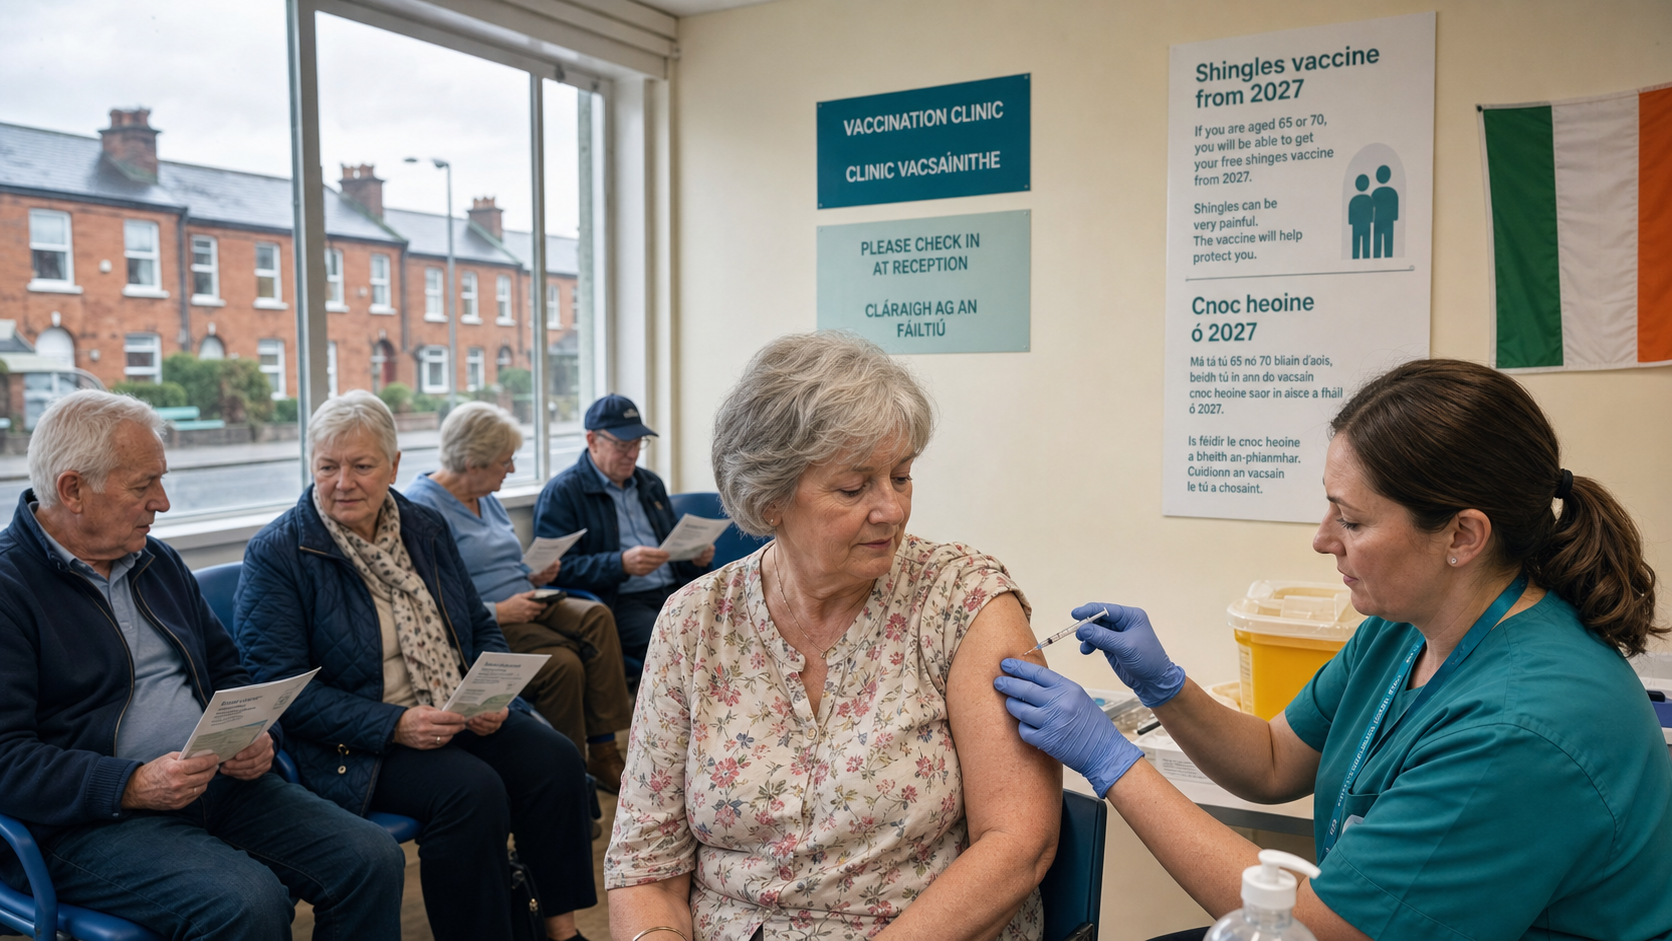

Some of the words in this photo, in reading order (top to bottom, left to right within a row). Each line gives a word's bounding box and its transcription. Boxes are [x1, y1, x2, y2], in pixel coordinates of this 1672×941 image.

[1196, 57, 1285, 82] Shingles
[1292, 46, 1380, 71] vaccine
[1196, 88, 1243, 108] from
[1251, 79, 1304, 103] 2027
[844, 107, 947, 136] VACCINATION
[951, 100, 1003, 123] CLINIC
[1195, 124, 1202, 137] If
[1205, 126, 1225, 139] you
[1228, 124, 1245, 134] are
[1248, 117, 1275, 134] aged
[1279, 116, 1292, 129] 65
[1296, 117, 1307, 127] or
[1310, 113, 1327, 126] 70,
[1195, 143, 1214, 156] you
[1217, 139, 1236, 151] will
[1238, 137, 1251, 149] be
[1255, 135, 1277, 147] able
[1281, 134, 1292, 145] to
[1295, 131, 1313, 146] get
[846, 161, 894, 182] CLINIC
[898, 150, 1000, 177] VACSAÍNITHE
[1194, 159, 1218, 172] your
[1222, 155, 1242, 167] free
[1246, 152, 1287, 166] shinges
[1291, 147, 1334, 161] vaccine
[1194, 174, 1219, 186] from
[1223, 170, 1251, 184] 2027.
[1194, 200, 1239, 215] Shingles
[1242, 200, 1261, 210] can
[1264, 197, 1277, 209] be
[1194, 220, 1216, 232] very
[1220, 215, 1258, 231] painful.
[862, 237, 911, 256] PLEASE
[915, 233, 961, 251] CHECK
[966, 232, 979, 248] IN
[1193, 234, 1213, 246] The
[1216, 232, 1256, 245] vaccine
[1259, 229, 1276, 242] will
[1280, 228, 1302, 242] help
[873, 260, 889, 275] AT
[893, 255, 967, 274] RECEPTION
[1194, 250, 1231, 265] protect
[1235, 250, 1257, 263] you.
[865, 299, 931, 317] CLÁRAIGH
[935, 300, 954, 315] AG
[958, 298, 977, 314] AN
[1192, 296, 1240, 315] Cnoc
[1247, 292, 1314, 313] heoine
[897, 318, 945, 337] FÁILTIÚ
[1192, 322, 1203, 342] ó
[1209, 321, 1257, 342] 2027
[1191, 355, 1204, 366] Má
[1207, 355, 1216, 366] tá
[1218, 355, 1227, 366] tú
[1230, 355, 1242, 366] 65
[1245, 355, 1256, 366] nó
[1260, 354, 1271, 366] 70
[1275, 354, 1300, 366] bliain
[1190, 371, 1216, 382] beidh
[1219, 371, 1228, 382] tú
[1232, 371, 1239, 382] in
[1243, 373, 1260, 382] ann
[1263, 370, 1275, 382] do
[1190, 389, 1212, 398] cnoc
[1215, 387, 1246, 398] heoine
[1249, 389, 1270, 398] saor
[1273, 387, 1282, 398] in
[1284, 387, 1309, 398] aisce
[1312, 389, 1318, 398] a
[1189, 402, 1195, 414] ó
[1198, 403, 1224, 414] 2027.
[1189, 435, 1196, 446] Is
[1199, 434, 1224, 446] féidir
[1228, 435, 1236, 446] le
[1239, 438, 1262, 447] cnoc
[1266, 436, 1300, 447] heoine
[1188, 453, 1194, 461] a
[1197, 450, 1227, 461] bheith
[1230, 451, 1300, 464] an-phianmhar.
[1188, 466, 1230, 478] Cuidionn
[1233, 469, 1245, 477] an
[1188, 480, 1196, 492] le
[1198, 480, 1208, 492] tú
[1211, 484, 1216, 492] a
[1219, 481, 1262, 493] chosaint.
